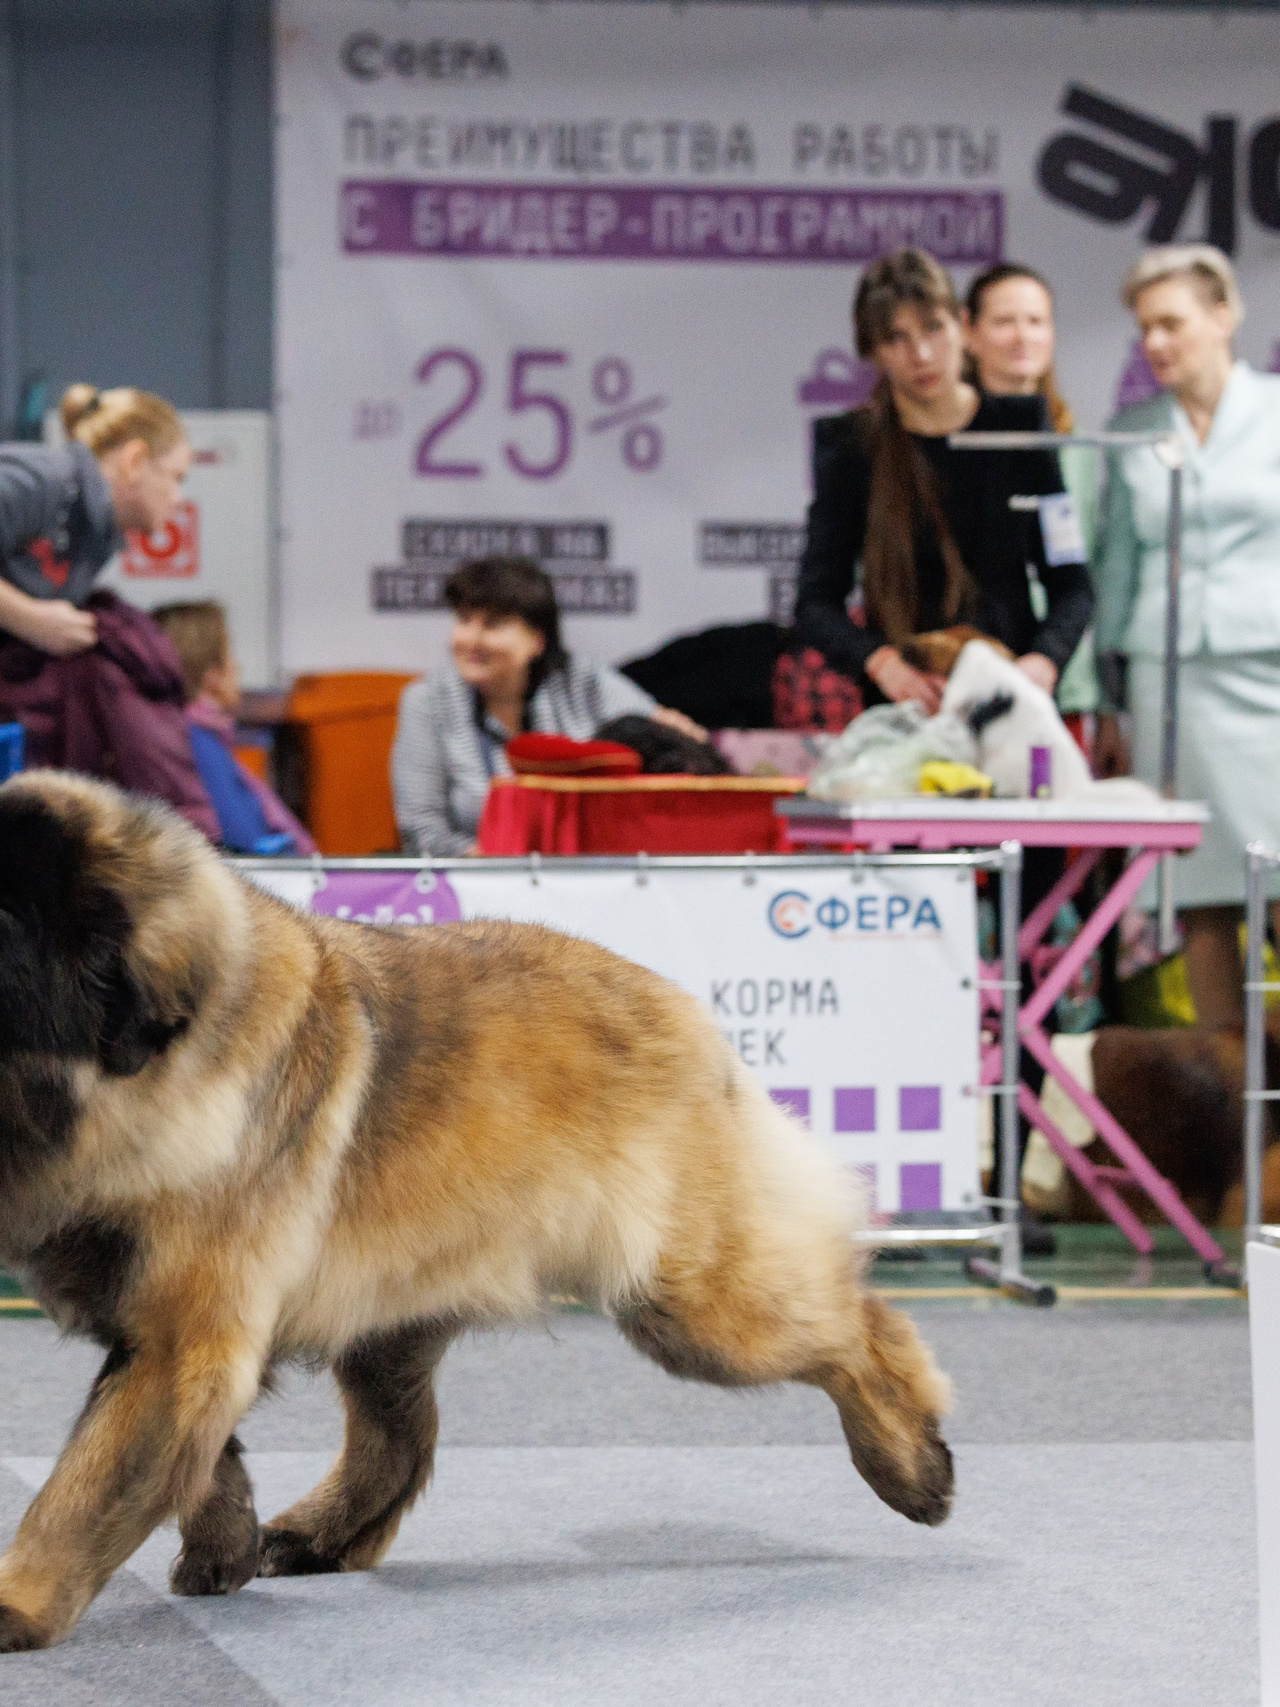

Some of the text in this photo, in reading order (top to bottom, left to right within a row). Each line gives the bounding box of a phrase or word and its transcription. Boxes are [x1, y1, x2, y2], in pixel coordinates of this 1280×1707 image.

[342, 114, 999, 179] ПРЕИМУЩЕСТВА РАБОТЫ
[347, 190, 998, 254] С БРИДЕР-ПРОГРАММОЙ
[414, 348, 665, 480] 25%
[768, 889, 943, 939] СФЕРА
[711, 977, 839, 1017] КОРМА
